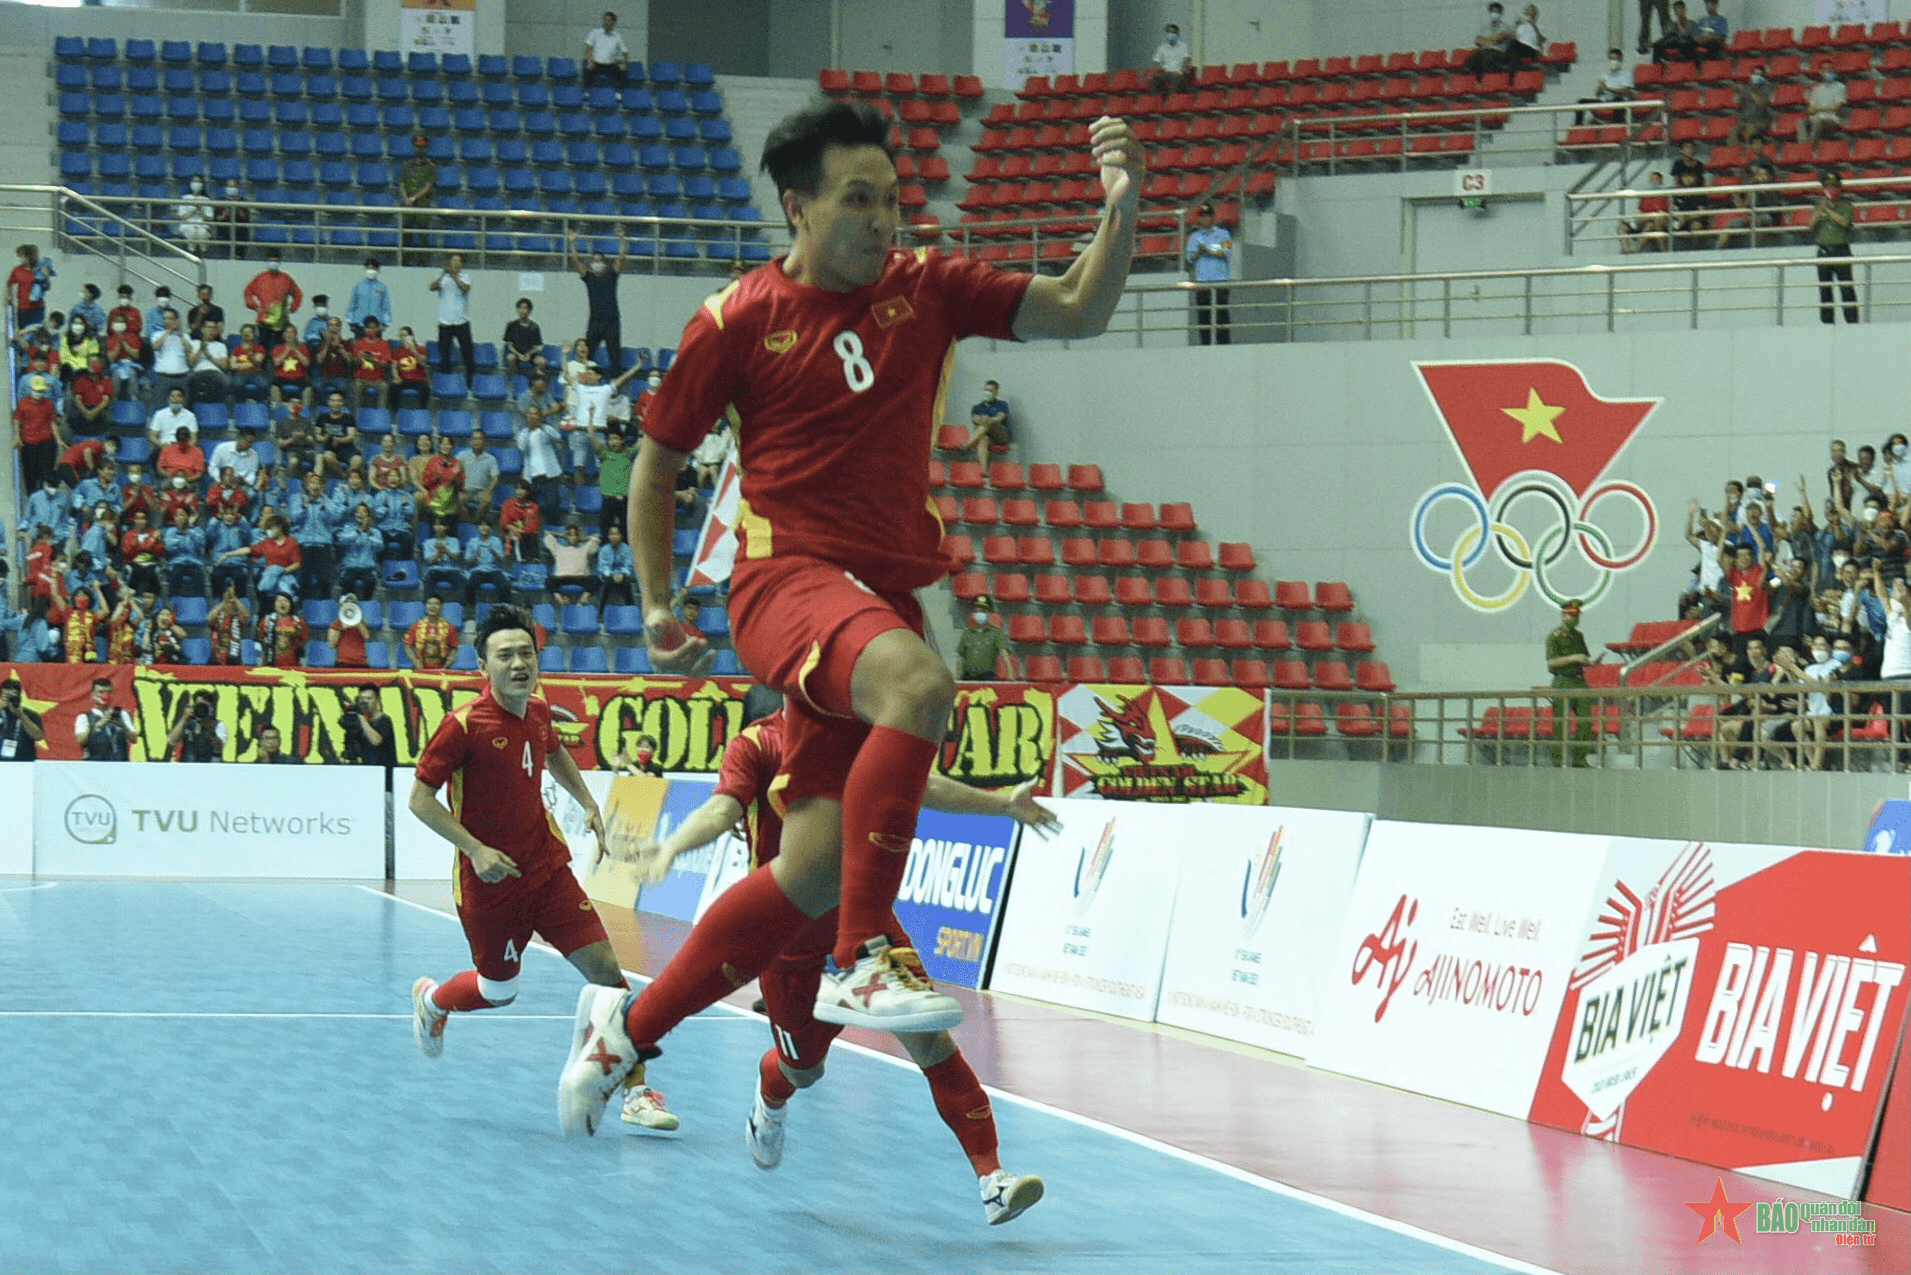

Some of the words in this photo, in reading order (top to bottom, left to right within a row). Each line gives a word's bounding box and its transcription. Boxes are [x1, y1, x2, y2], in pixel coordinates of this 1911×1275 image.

[1462, 173, 1485, 191] C3
[833, 330, 875, 393] 8
[522, 741, 533, 777] 4
[72, 811, 111, 826] TVU
[132, 810, 199, 832] TVU
[209, 810, 351, 836] Networks
[897, 837, 1006, 915] DONGLUC
[504, 938, 519, 962] 4
[1574, 985, 1625, 1064] BIA
[1625, 953, 1688, 1044] VIỆT
[1695, 942, 1794, 1074] BIA
[1781, 933, 1906, 1112] VIỆT
[774, 1023, 800, 1061] 11
